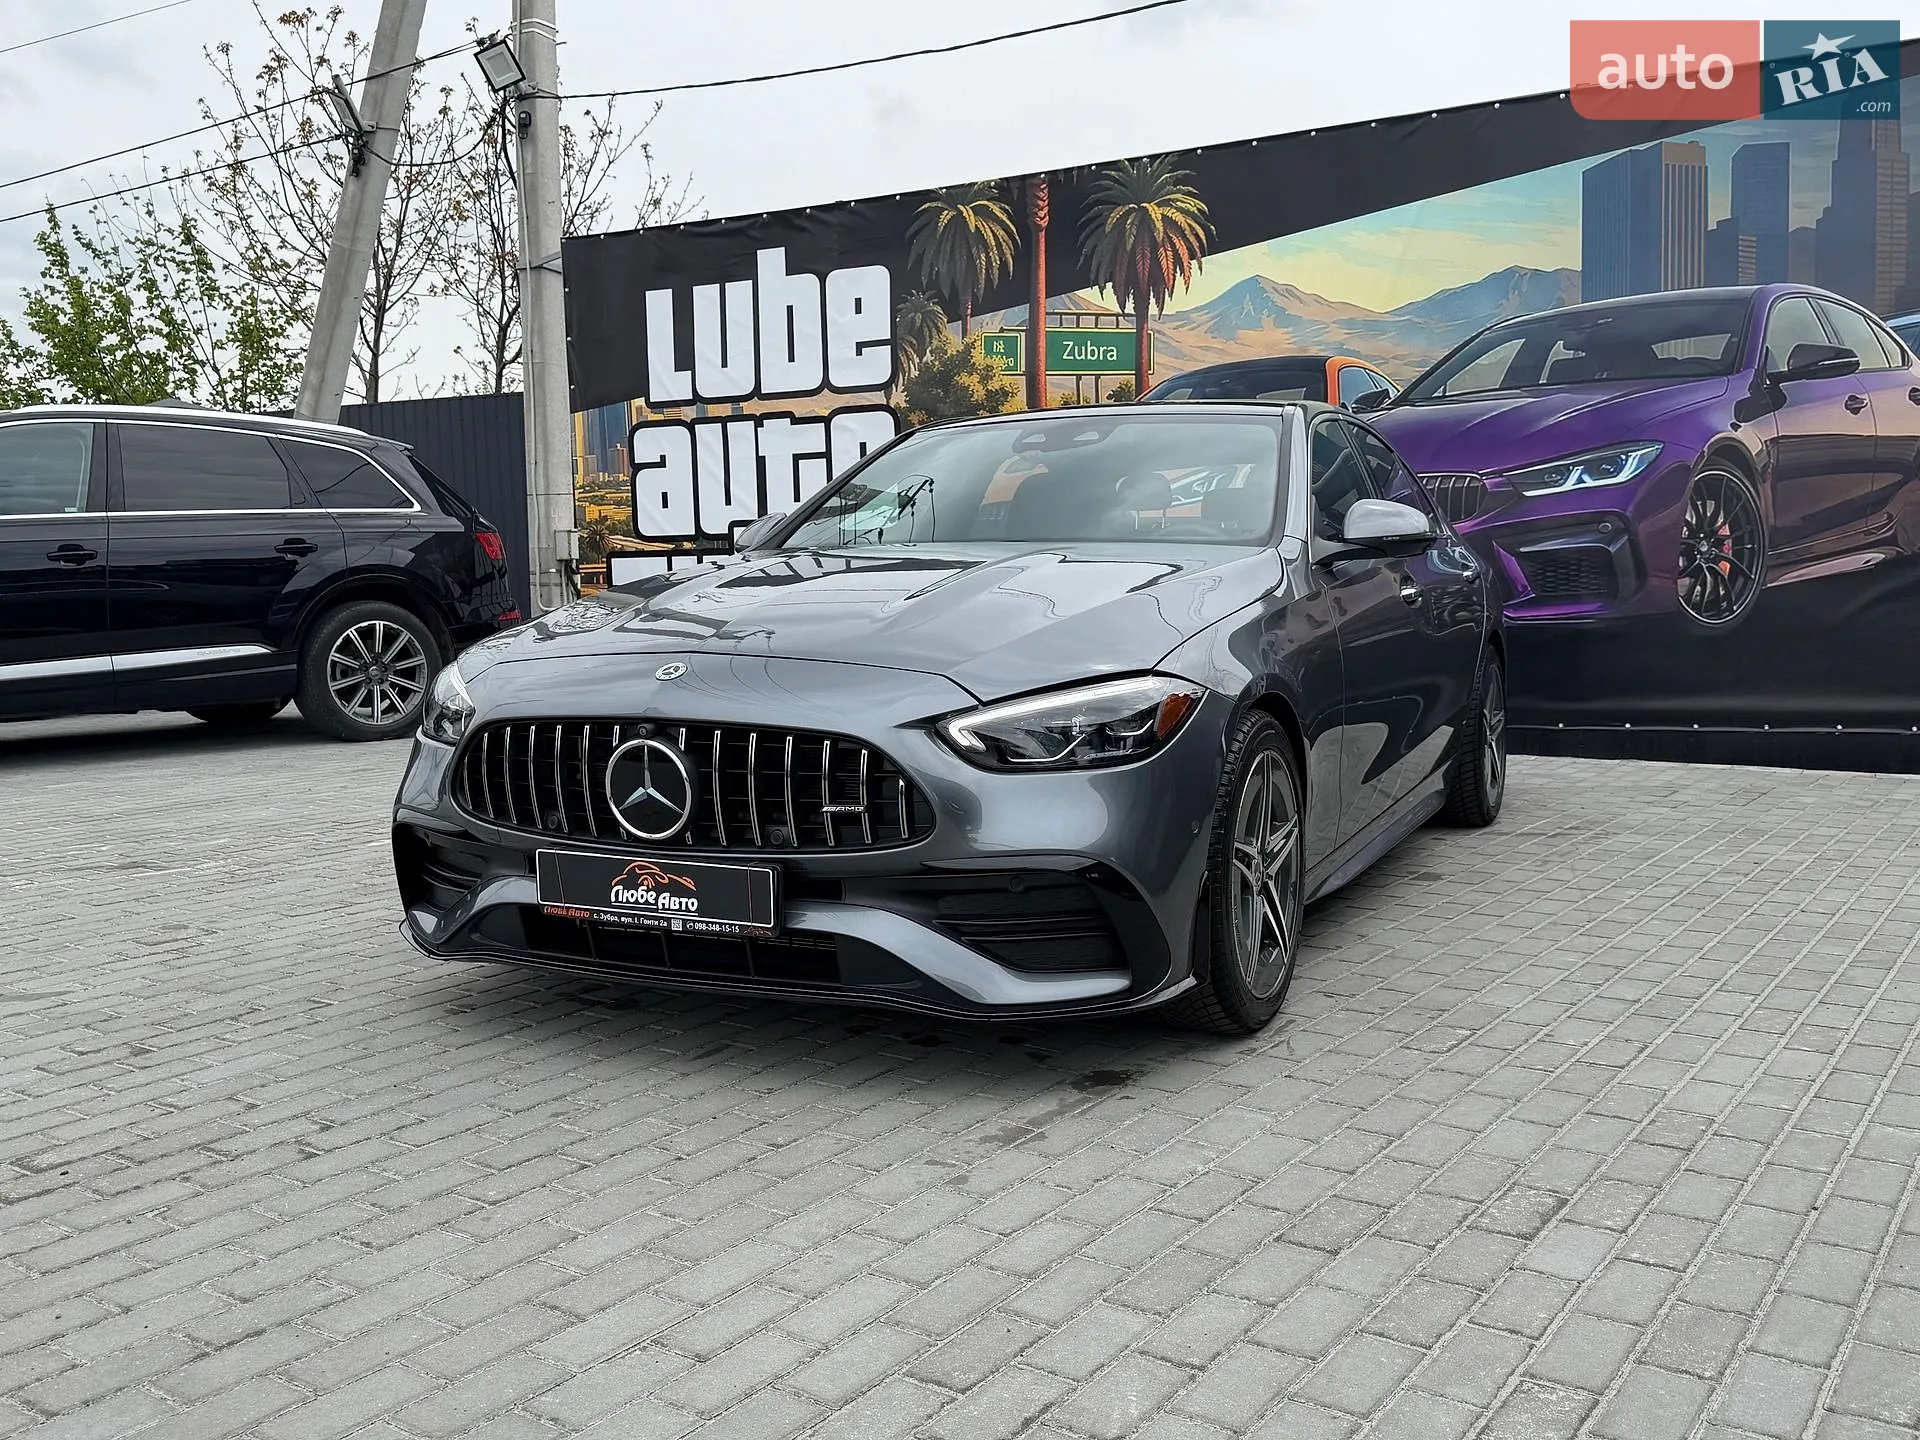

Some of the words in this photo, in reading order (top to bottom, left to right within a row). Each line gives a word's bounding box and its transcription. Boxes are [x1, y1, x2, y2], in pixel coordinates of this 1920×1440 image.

[1062, 341, 1118, 361] Zubra
[657, 892, 699, 912] Авто
[694, 922, 740, 933] 098-348-15-15
